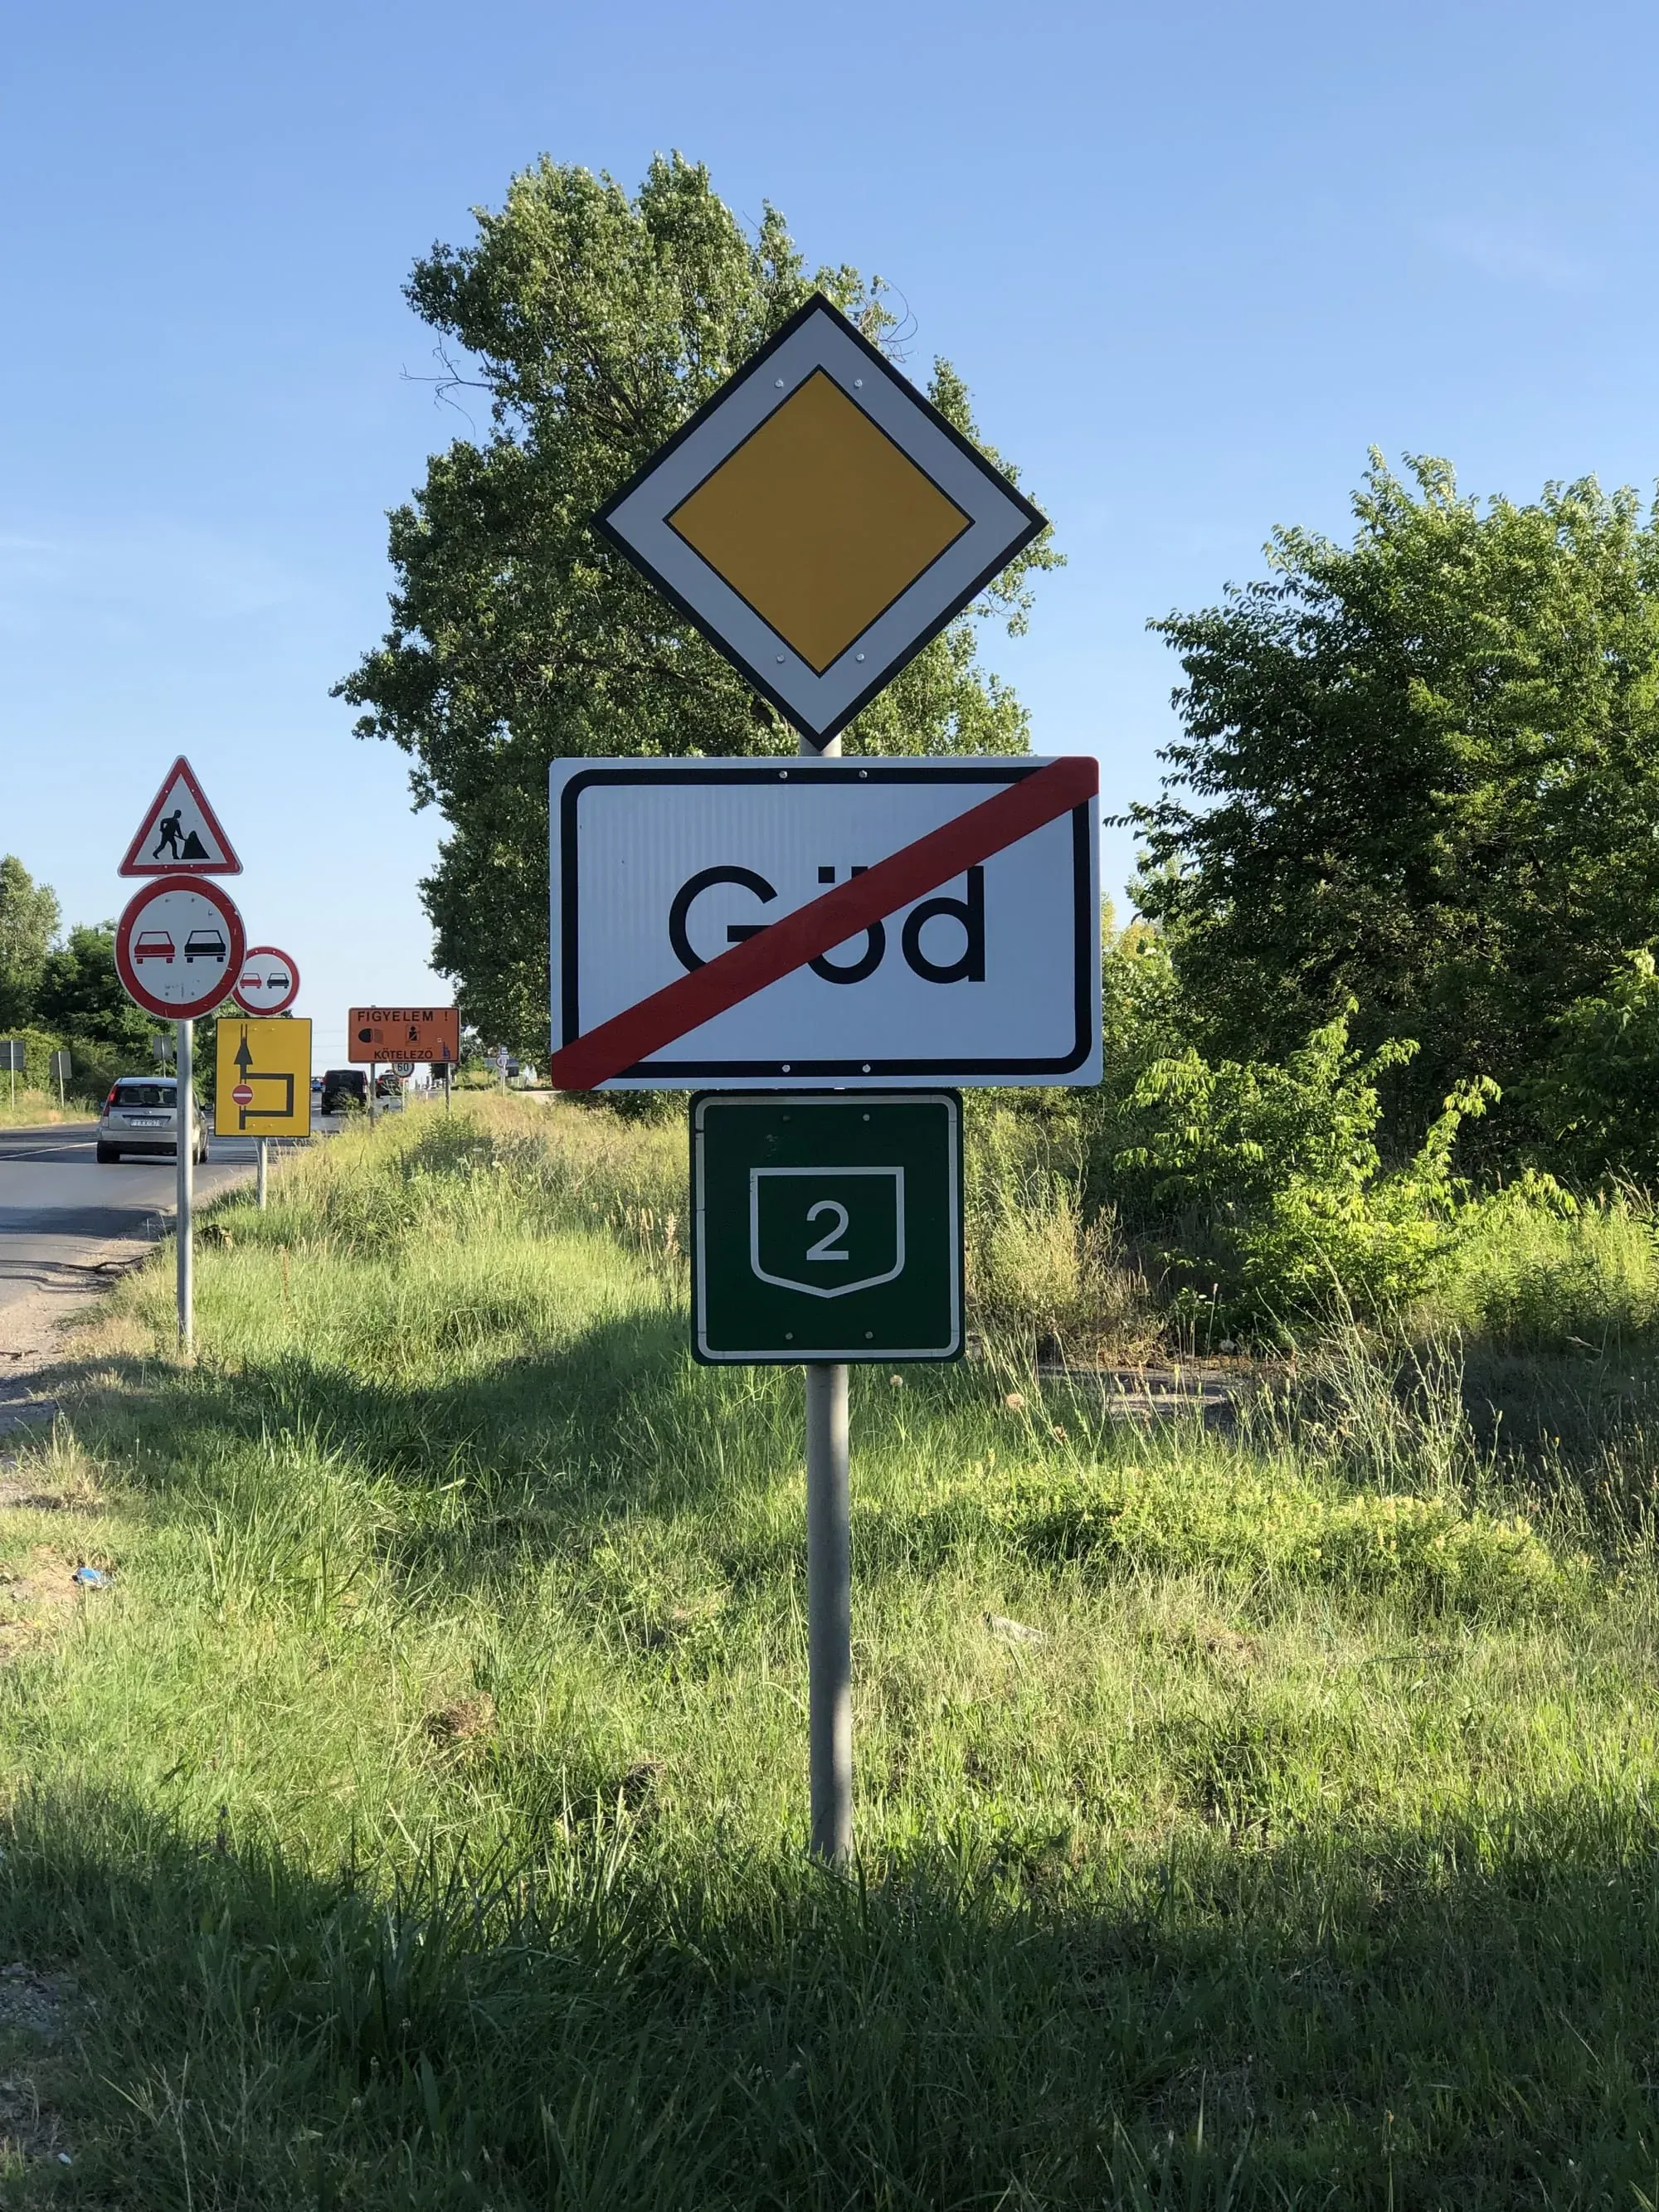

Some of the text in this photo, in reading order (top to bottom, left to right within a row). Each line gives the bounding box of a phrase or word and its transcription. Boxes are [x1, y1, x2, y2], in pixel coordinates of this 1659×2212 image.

[358, 1011, 433, 1022] FIGYELEM
[397, 1062, 409, 1072] 60
[806, 1200, 849, 1260] 2
